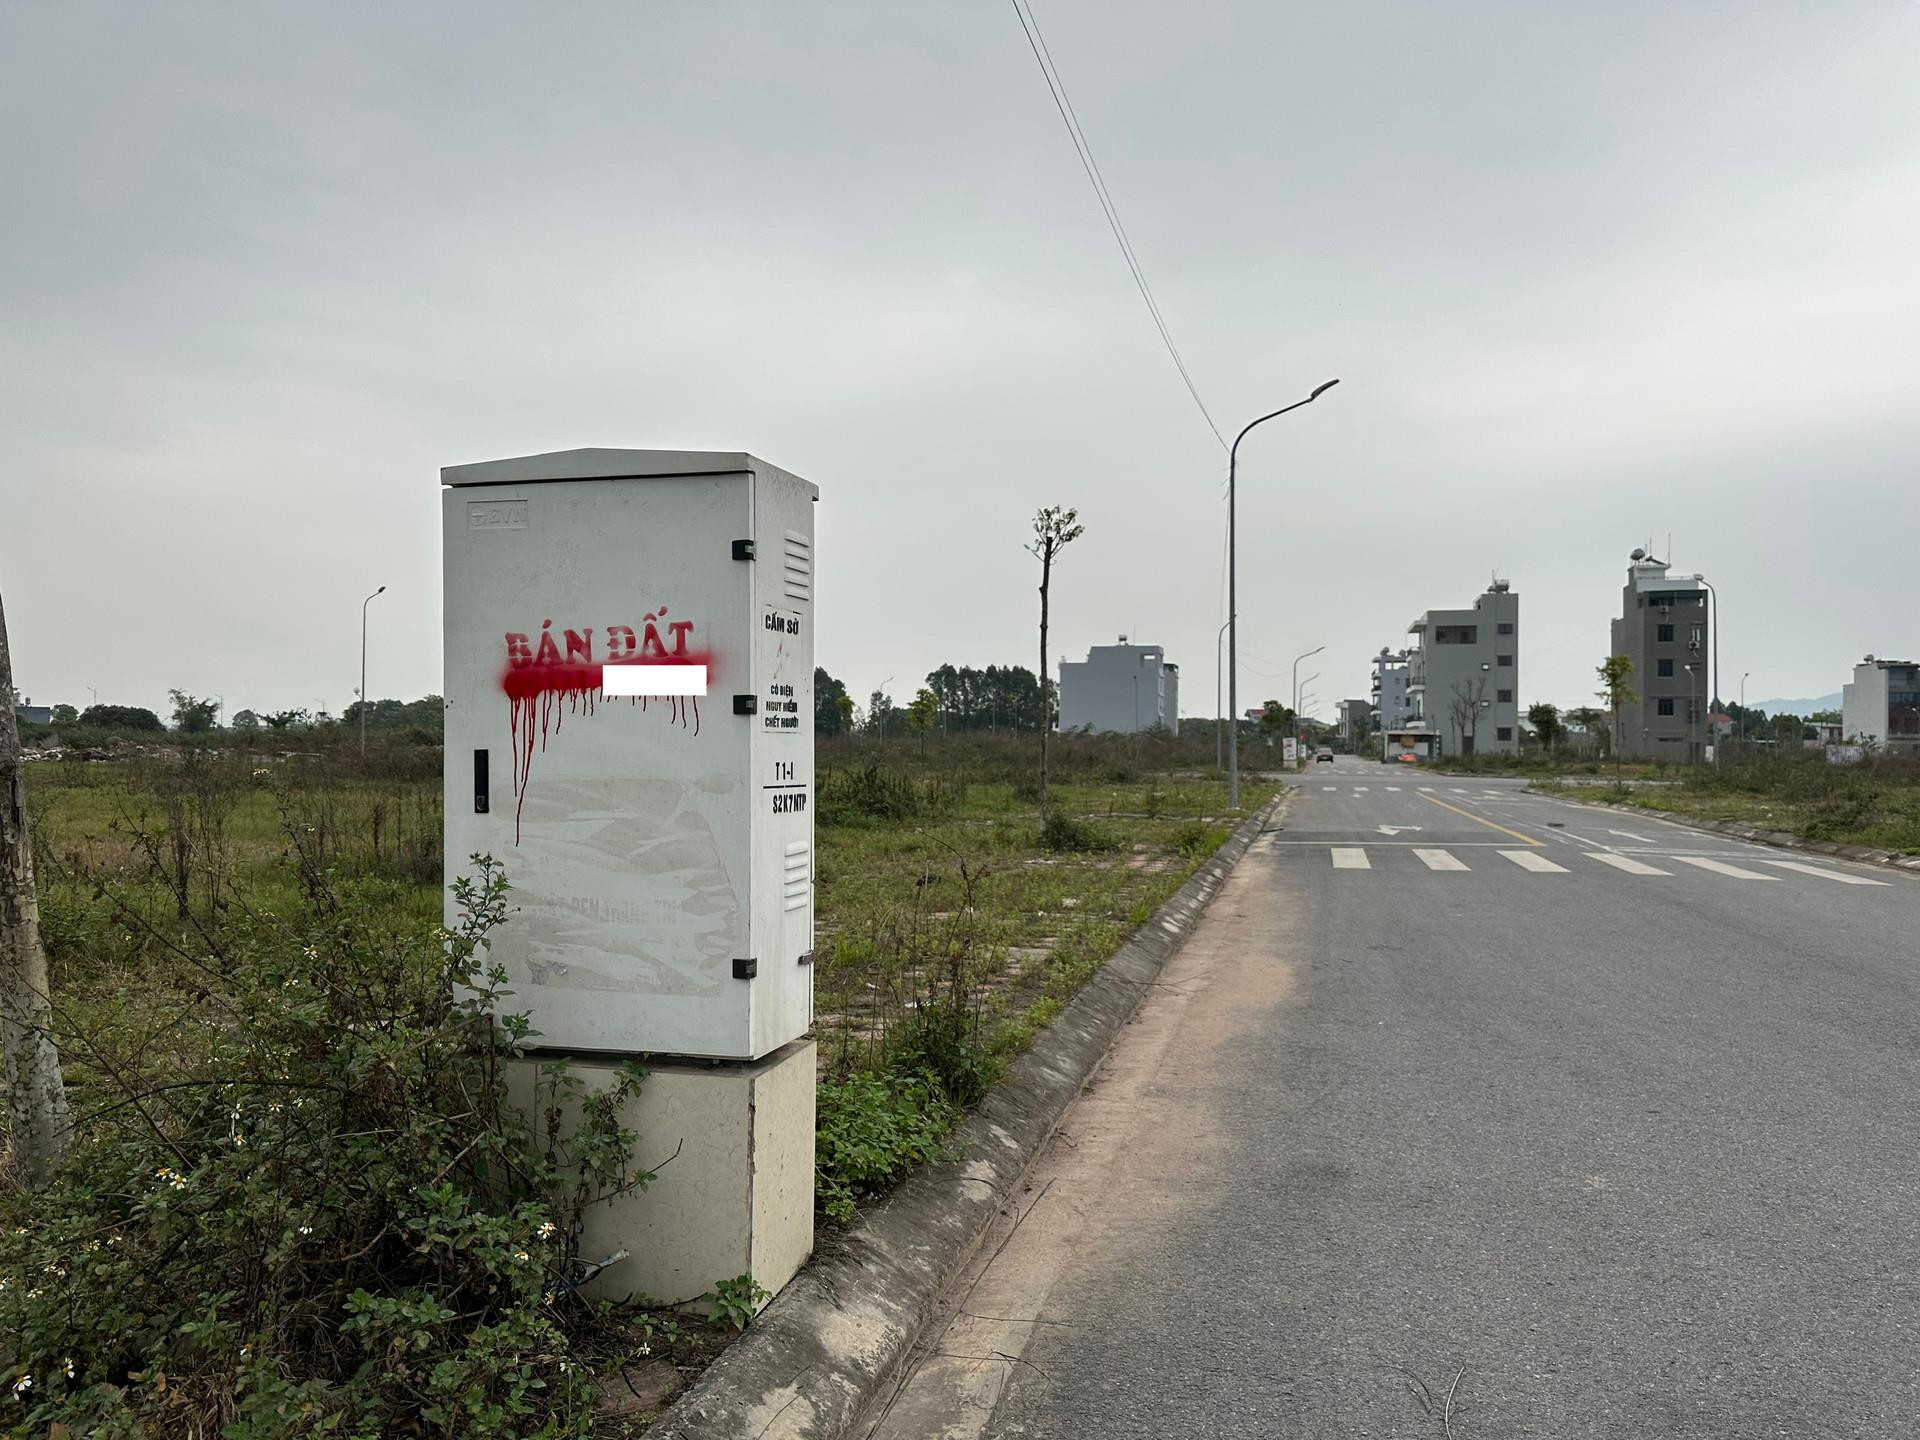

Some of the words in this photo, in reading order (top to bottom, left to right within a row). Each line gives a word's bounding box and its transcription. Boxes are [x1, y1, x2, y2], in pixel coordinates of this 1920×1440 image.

[505, 618, 593, 668] BÁN
[607, 606, 694, 660] ĐẤT
[770, 683, 779, 696] CÓ
[765, 700, 782, 712] NGUY
